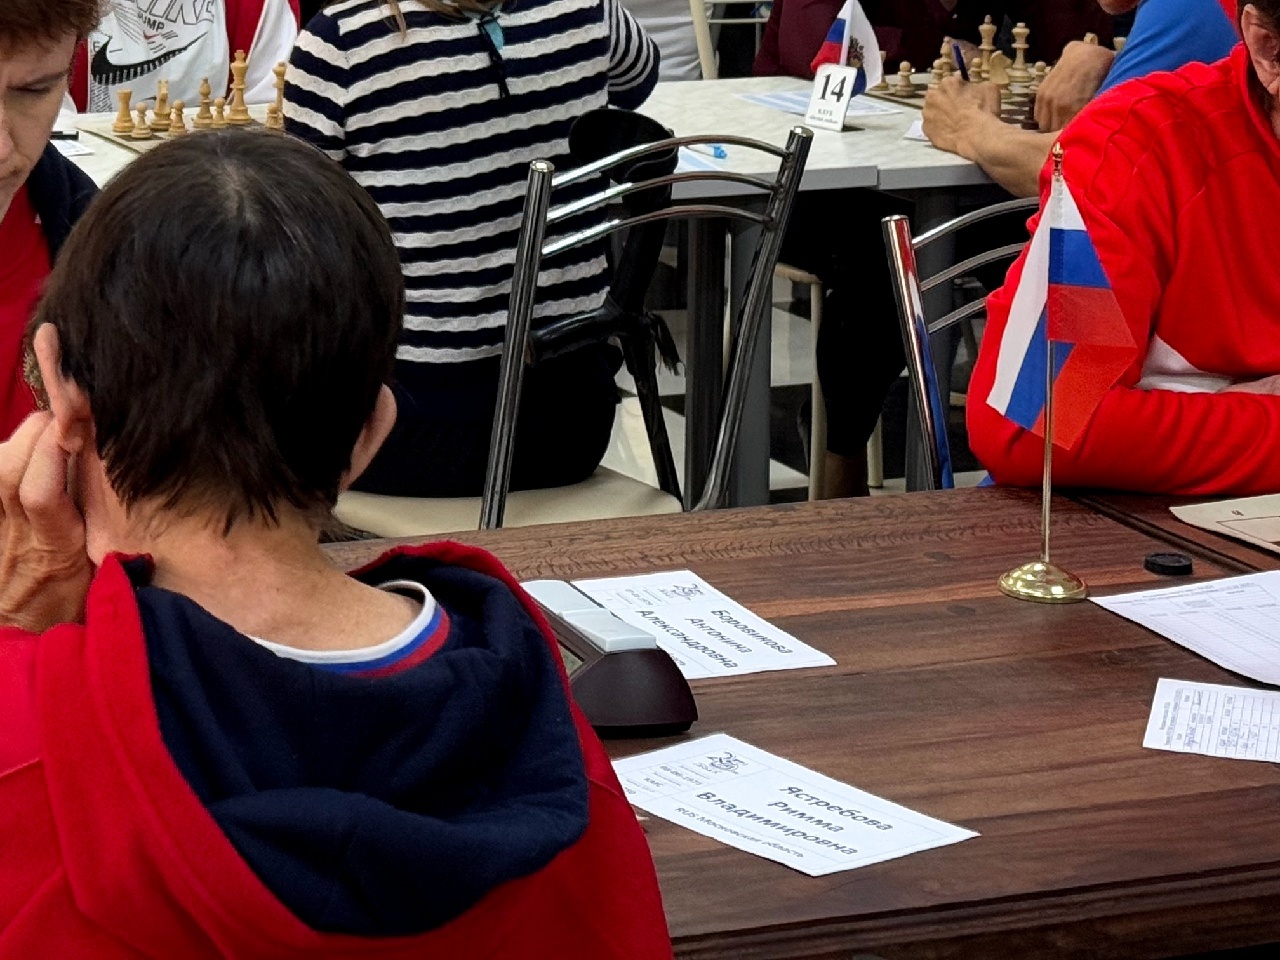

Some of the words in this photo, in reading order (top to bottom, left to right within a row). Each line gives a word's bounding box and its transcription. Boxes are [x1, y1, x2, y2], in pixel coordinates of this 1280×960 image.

[818, 73, 847, 103] 14
[635, 610, 738, 669] Александровна
[684, 617, 753, 654] Антонина
[696, 791, 858, 856] Владимировна
[767, 800, 844, 833] Римма
[779, 786, 894, 831] Ястребова
